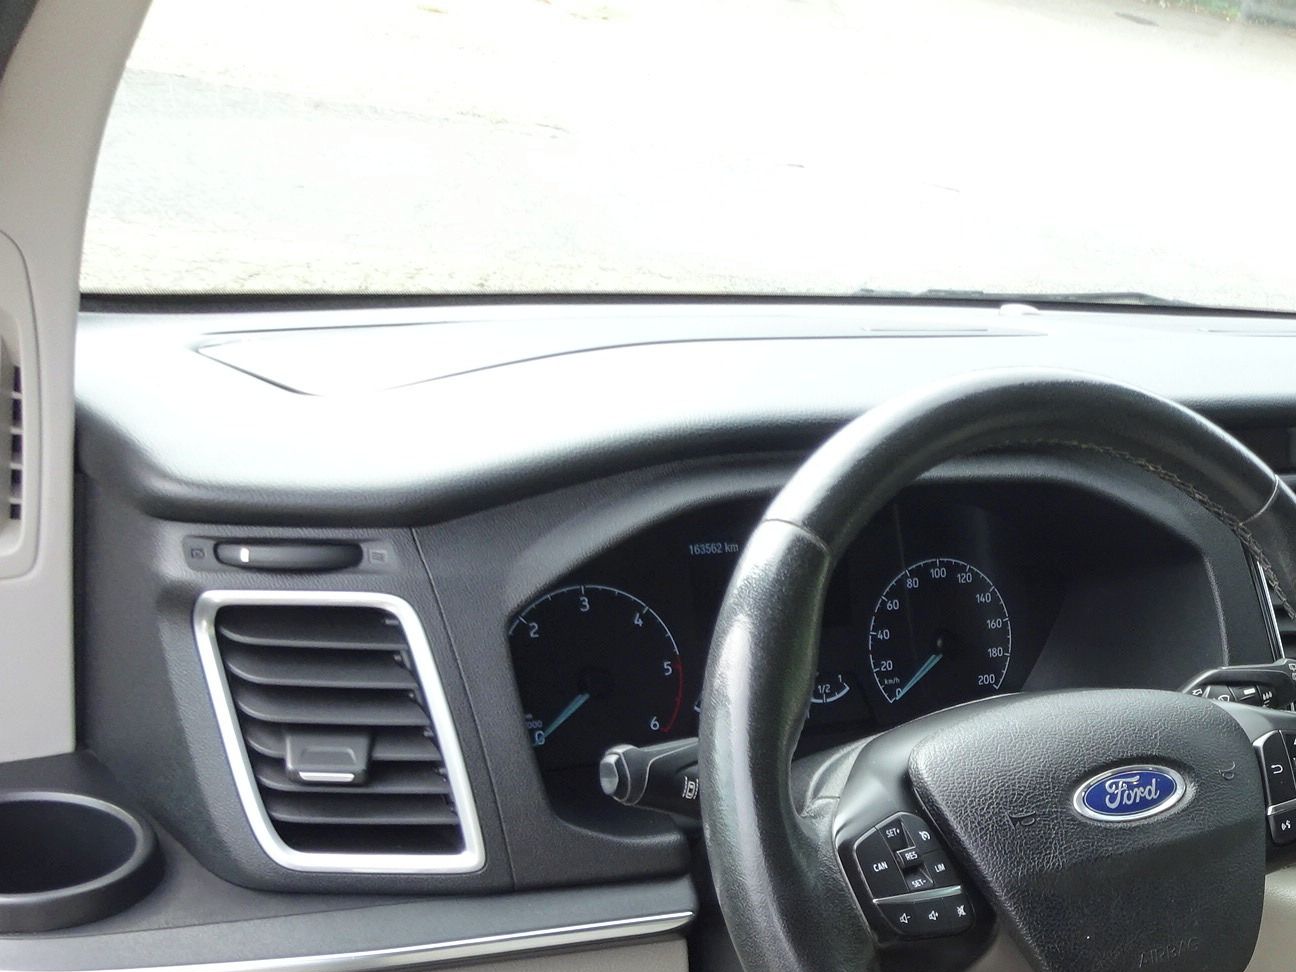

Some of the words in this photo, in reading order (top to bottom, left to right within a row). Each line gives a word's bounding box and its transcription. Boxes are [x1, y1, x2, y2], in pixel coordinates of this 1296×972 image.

[724, 542, 739, 552] km
[930, 567, 947, 578] 100
[906, 577, 919, 589] 80
[957, 573, 972, 584] 120
[976, 592, 992, 603] 140
[580, 596, 590, 612] 3
[886, 600, 900, 610] 60
[634, 612, 643, 627] 4
[987, 618, 1002, 629] 160
[529, 622, 539, 638] 2
[877, 629, 890, 640] 40
[987, 647, 1003, 658] 180
[663, 661, 672, 676] 5
[880, 660, 893, 671] 20
[884, 677, 900, 685] km/h
[978, 674, 995, 685] 200
[817, 684, 831, 694] 1/2
[650, 716, 660, 731] 6
[1105, 775, 1160, 809] Ford
[904, 851, 918, 861] RES
[873, 861, 888, 872] CAN
[934, 863, 946, 873] LIM
